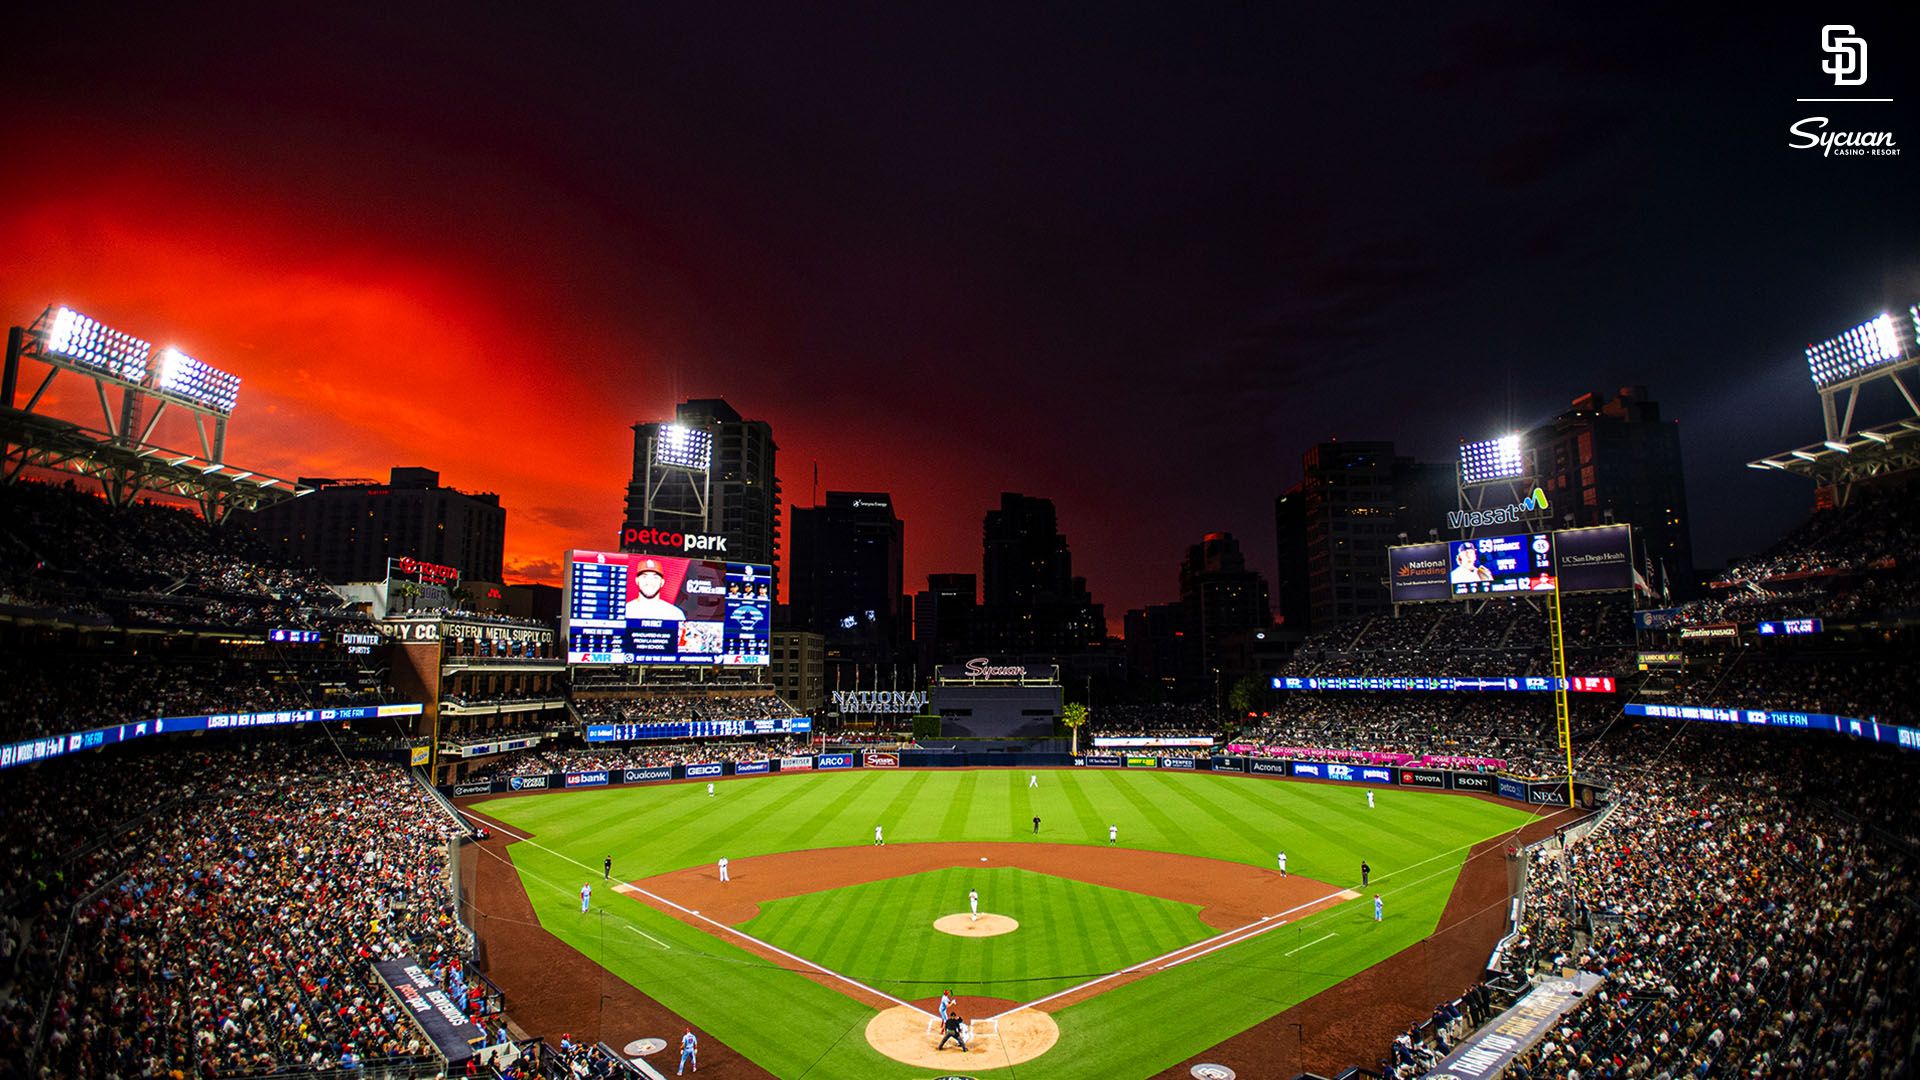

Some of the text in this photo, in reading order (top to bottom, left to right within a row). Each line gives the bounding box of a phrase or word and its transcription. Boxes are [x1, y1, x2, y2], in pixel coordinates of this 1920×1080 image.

[1448, 504, 1519, 529] Viasat
[1573, 555, 1584, 563] San
[1585, 554, 1603, 563] Diego
[1603, 552, 1625, 560] Health
[1409, 559, 1446, 569] National
[417, 561, 458, 580] TOYOTA
[1409, 568, 1447, 577] Funding
[415, 625, 439, 640] CO.
[442, 624, 553, 644] WESTERN METAL SUPPLY CO.
[343, 634, 379, 645] CUTWATER
[348, 646, 370, 654] SPIRITS
[965, 657, 1027, 681] Sycuan
[832, 690, 929, 704] NATIONAL
[840, 703, 923, 713] UNIVERSITY
[340, 710, 352, 719] THE
[353, 709, 365, 718] FAN
[1771, 713, 1788, 725] THE
[1789, 714, 1808, 727] FAN
[820, 757, 843, 766] ARCO
[1253, 762, 1282, 772] Acronis
[626, 770, 671, 782] Qualcomm
[687, 765, 721, 776] GEICO
[1414, 775, 1441, 783] TOYOTA
[1458, 777, 1489, 786] SONY
[1447, 1033, 1516, 1075] THANK YOU
